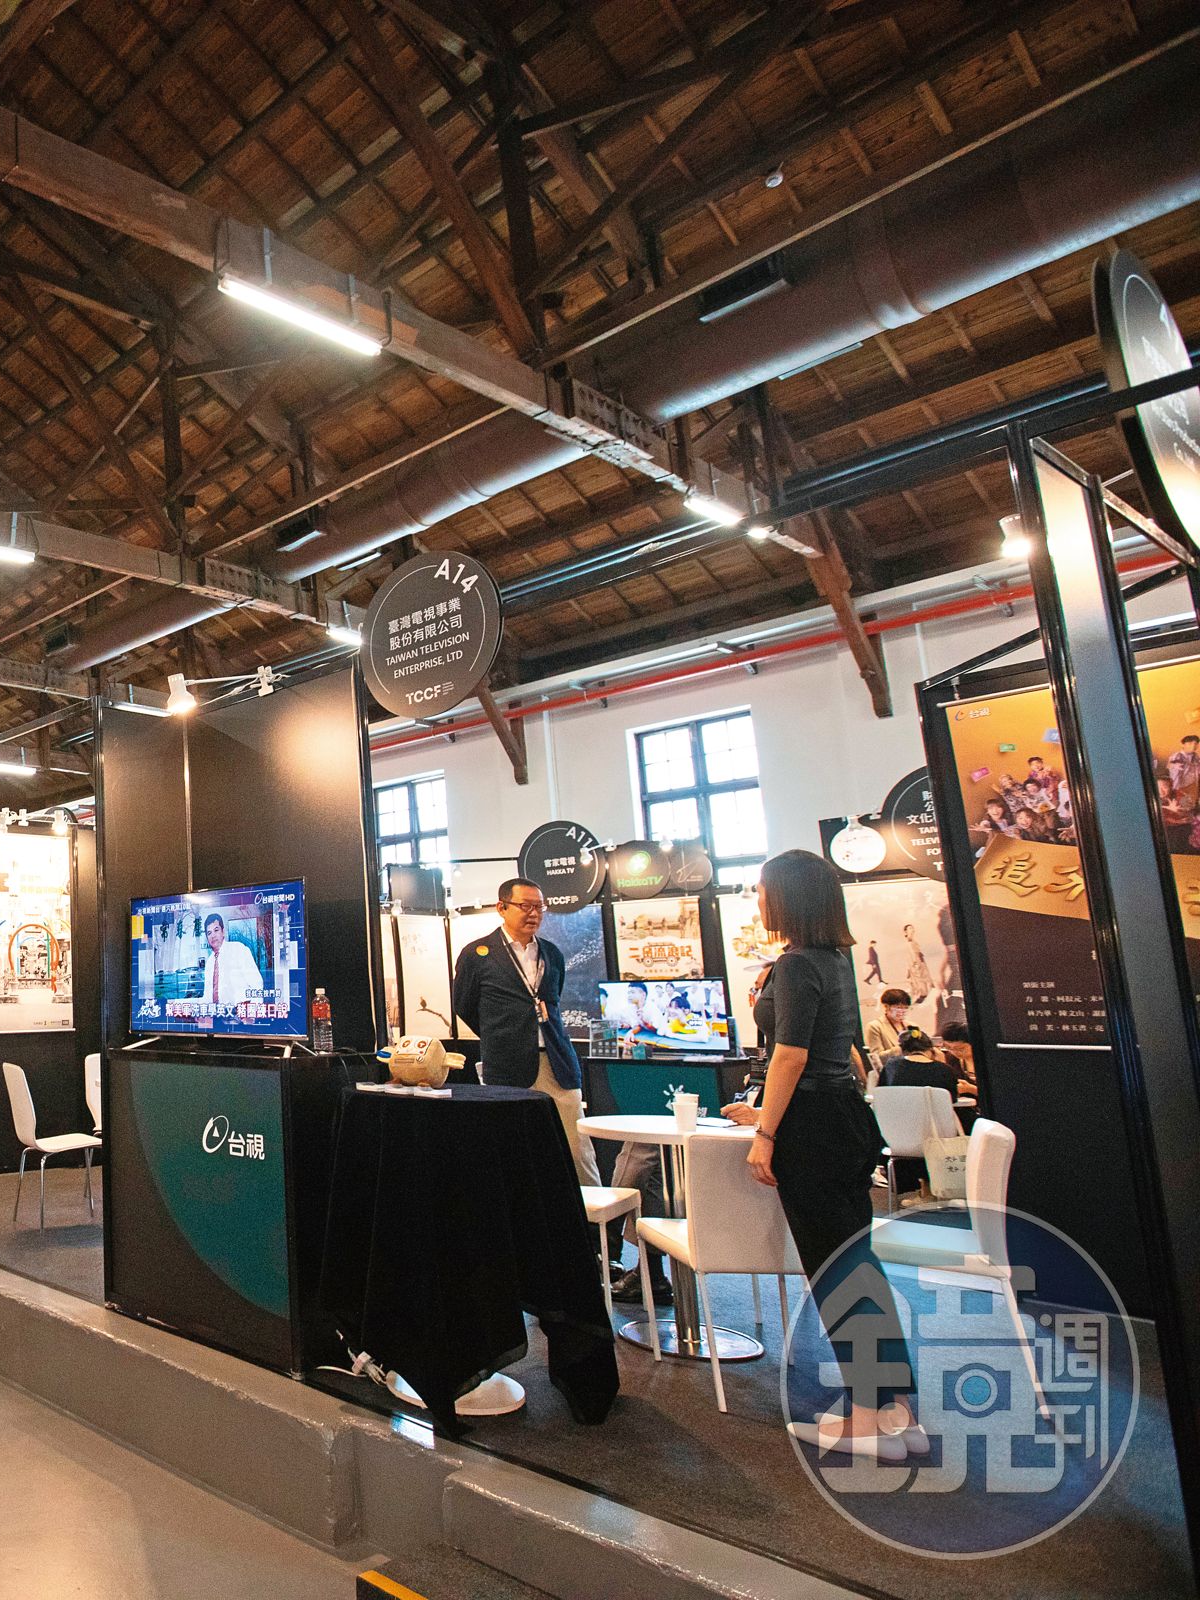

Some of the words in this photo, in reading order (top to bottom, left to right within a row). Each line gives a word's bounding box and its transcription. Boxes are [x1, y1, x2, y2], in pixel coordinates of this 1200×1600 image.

[434, 558, 479, 594] A14
[388, 597, 461, 635] 臺灣電視事業
[389, 614, 462, 651] 股份有限公司
[385, 648, 418, 666] TAIWAN
[420, 631, 470, 656] TELEVISION
[393, 659, 445, 679] ENTERPRISE,
[447, 650, 463, 663] LTD
[405, 685, 442, 704] TCCF
[906, 813, 936, 825] 文化
[566, 826, 594, 850] A11
[544, 857, 576, 868] 客家電視
[546, 868, 566, 876] HAKKA
[617, 875, 663, 888] HakkaTV
[547, 896, 571, 905] TCCF
[228, 1130, 265, 1160] 台視
